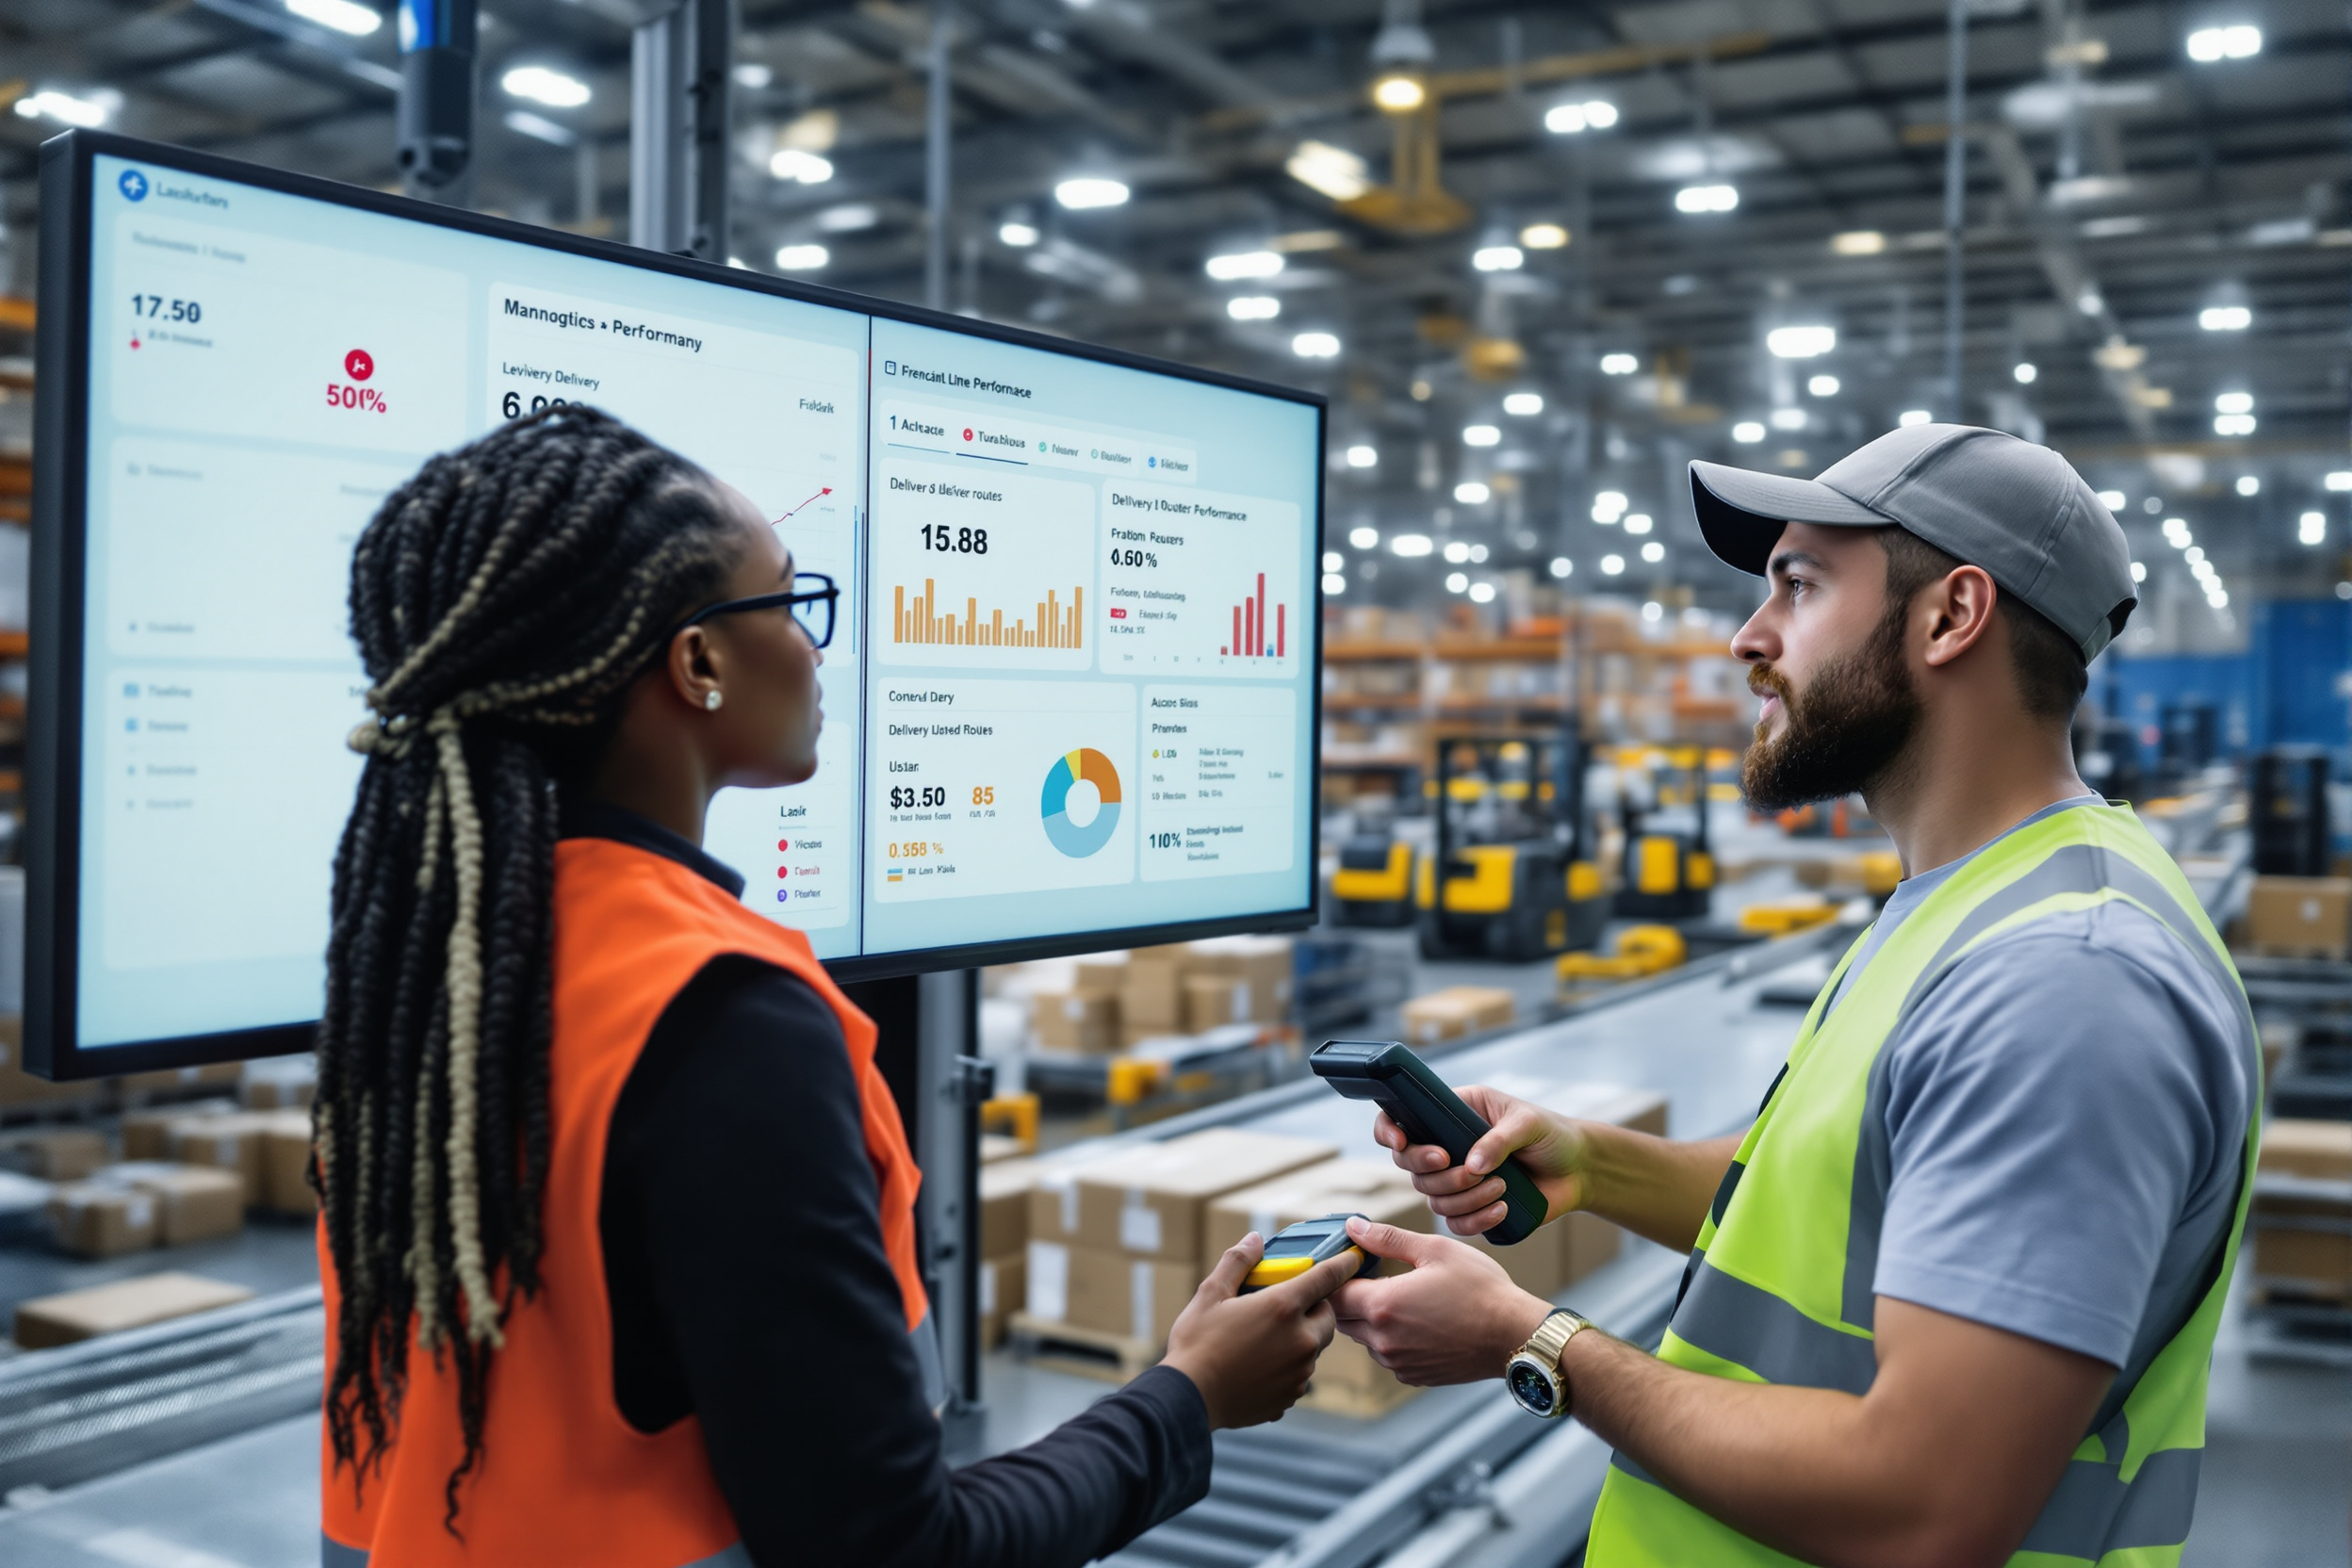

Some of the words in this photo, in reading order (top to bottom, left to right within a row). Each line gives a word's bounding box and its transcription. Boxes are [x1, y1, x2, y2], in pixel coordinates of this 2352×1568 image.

[132, 294, 201, 324] 17.50
[612, 319, 702, 352] Performany
[555, 370, 599, 391] Delivery
[890, 477, 927, 493] Deliver
[921, 524, 988, 555] 15.88
[889, 724, 929, 738] Delivery
[890, 785, 946, 810] $3.50
[972, 786, 994, 806] 85
